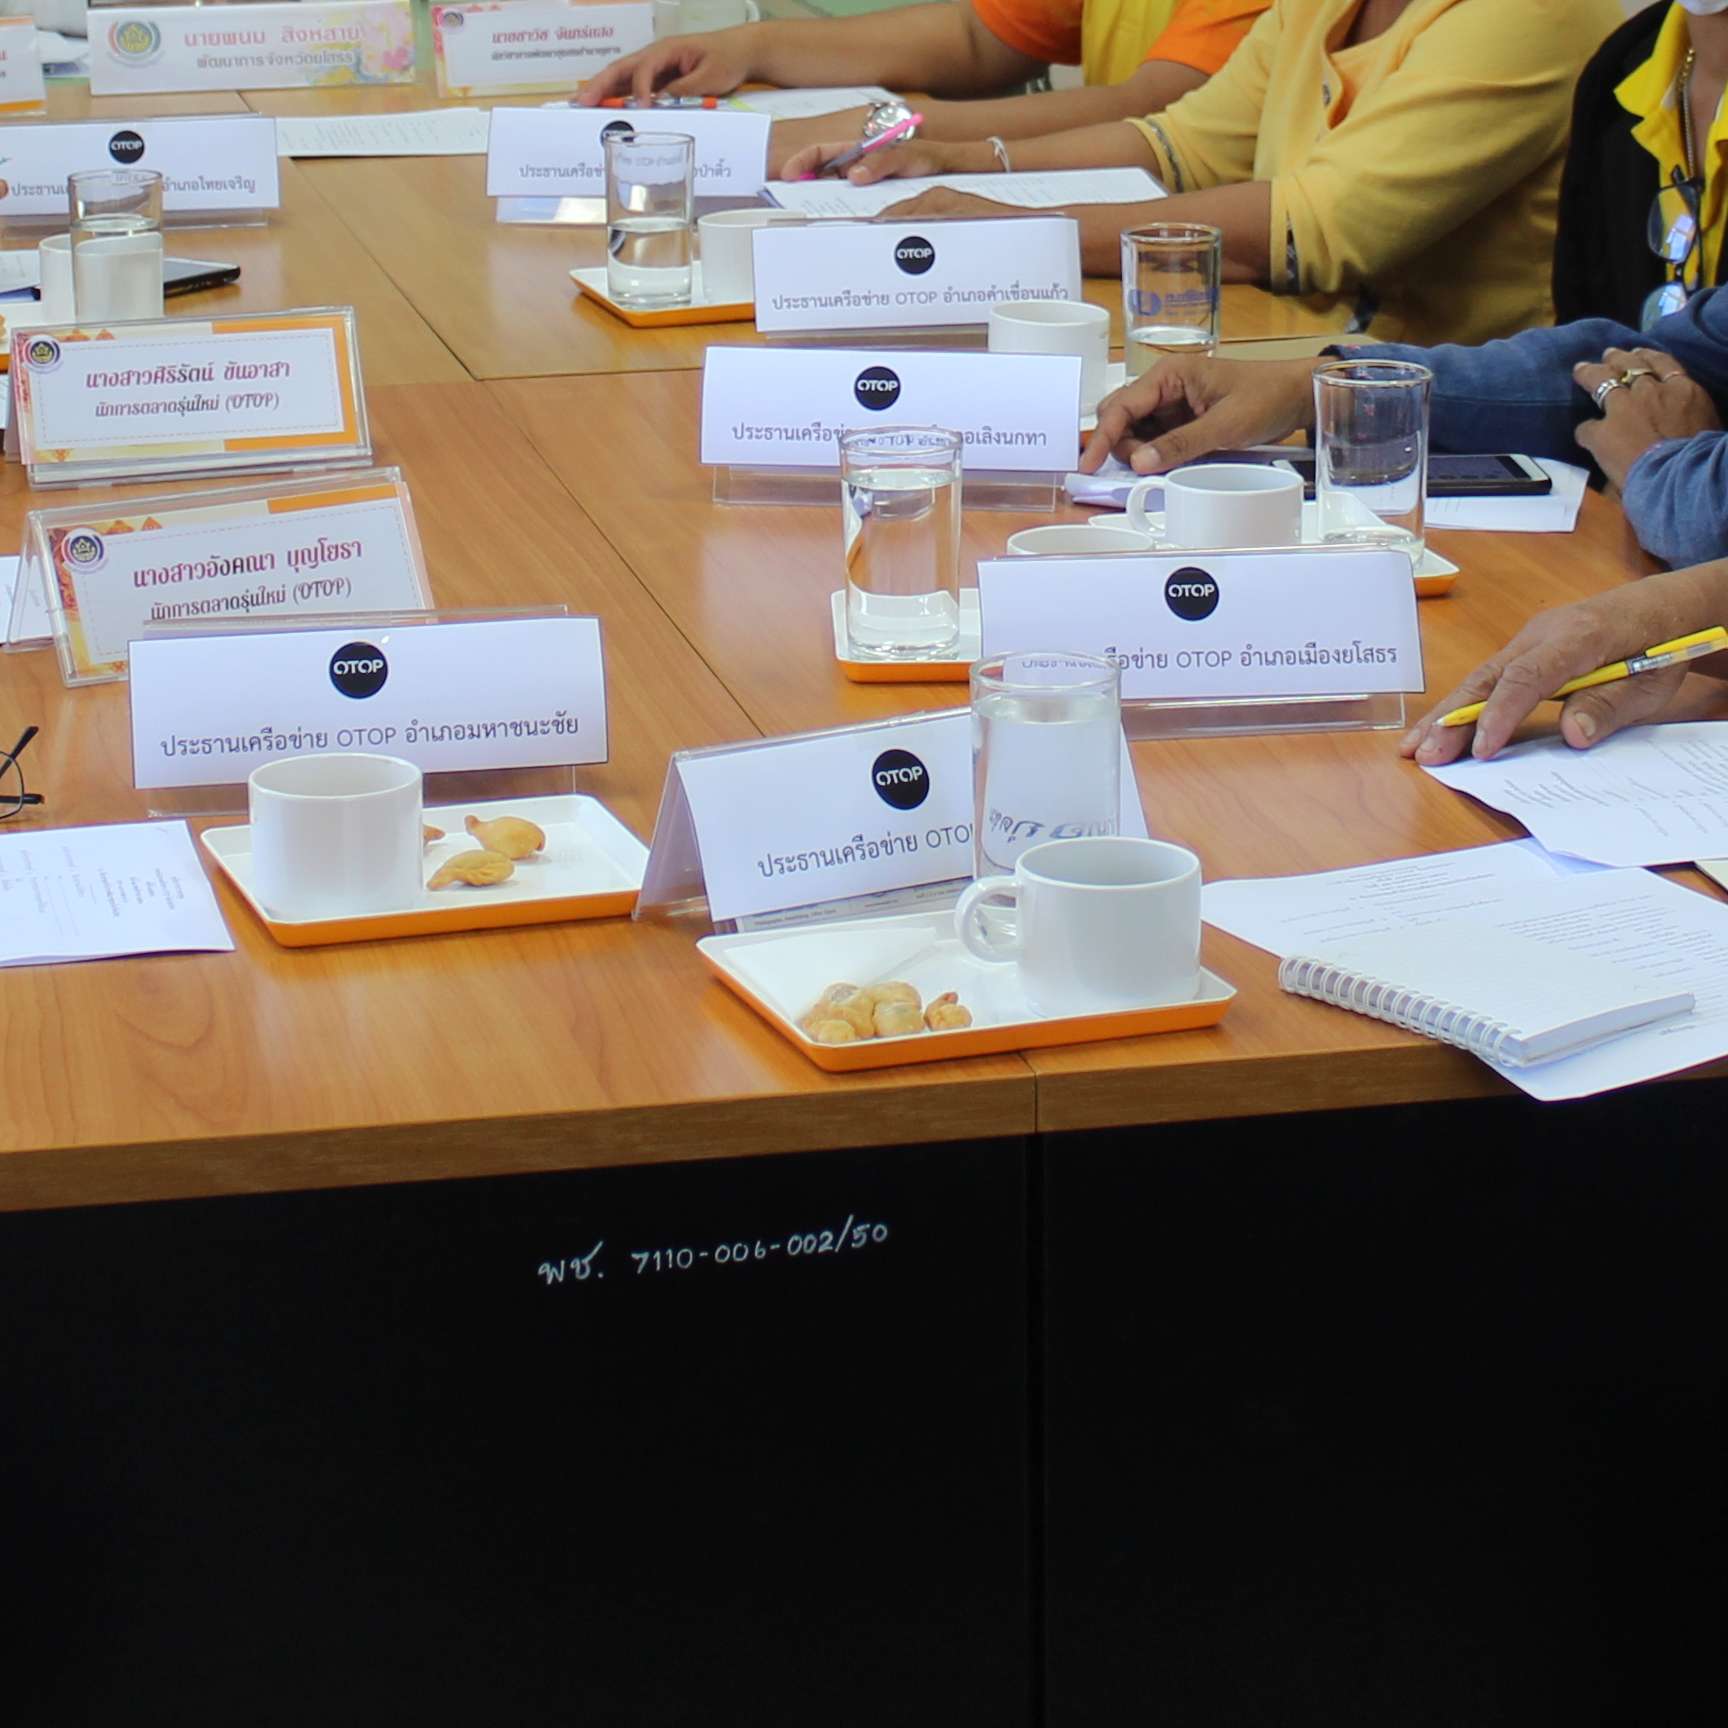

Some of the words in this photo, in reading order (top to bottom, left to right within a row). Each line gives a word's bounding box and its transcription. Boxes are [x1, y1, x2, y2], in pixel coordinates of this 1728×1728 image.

[184, 30, 266, 47] นายพนม
[110, 140, 143, 152] OTOP
[896, 247, 933, 260] OTOP
[772, 289, 889, 311] ประธานเครือข่าย
[895, 292, 938, 306] OTOP
[943, 281, 1069, 305] อำเภอคำเขื่อนแก้ว
[86, 363, 214, 388] นางสาวศิริรัตน์
[857, 379, 898, 392] OTOP
[95, 394, 219, 417] นักการตลาดรุ่นใหม่
[225, 392, 280, 413] (OTOP)
[134, 555, 276, 588] นางสาวอังคณา
[287, 538, 363, 573] บุญโยธา
[151, 585, 286, 620] นักการตลาดรุ่นใหม่
[293, 577, 352, 605] (OTOP)
[1168, 584, 1215, 598] OTOP
[1176, 650, 1232, 667] OTOP
[1240, 641, 1398, 667] อำเภอเมืองยโสธร
[333, 659, 384, 676] OTOP
[160, 726, 329, 758] ประธานเครือข่าย
[337, 728, 396, 748] OTOP
[405, 710, 580, 745] อำเภอมหาชนะชัย
[875, 765, 923, 787] OTOP
[757, 833, 918, 878] ประธานเครือข่าย
[925, 823, 972, 848] OTO
[631, 1214, 888, 1274] 7110-006-002/50
